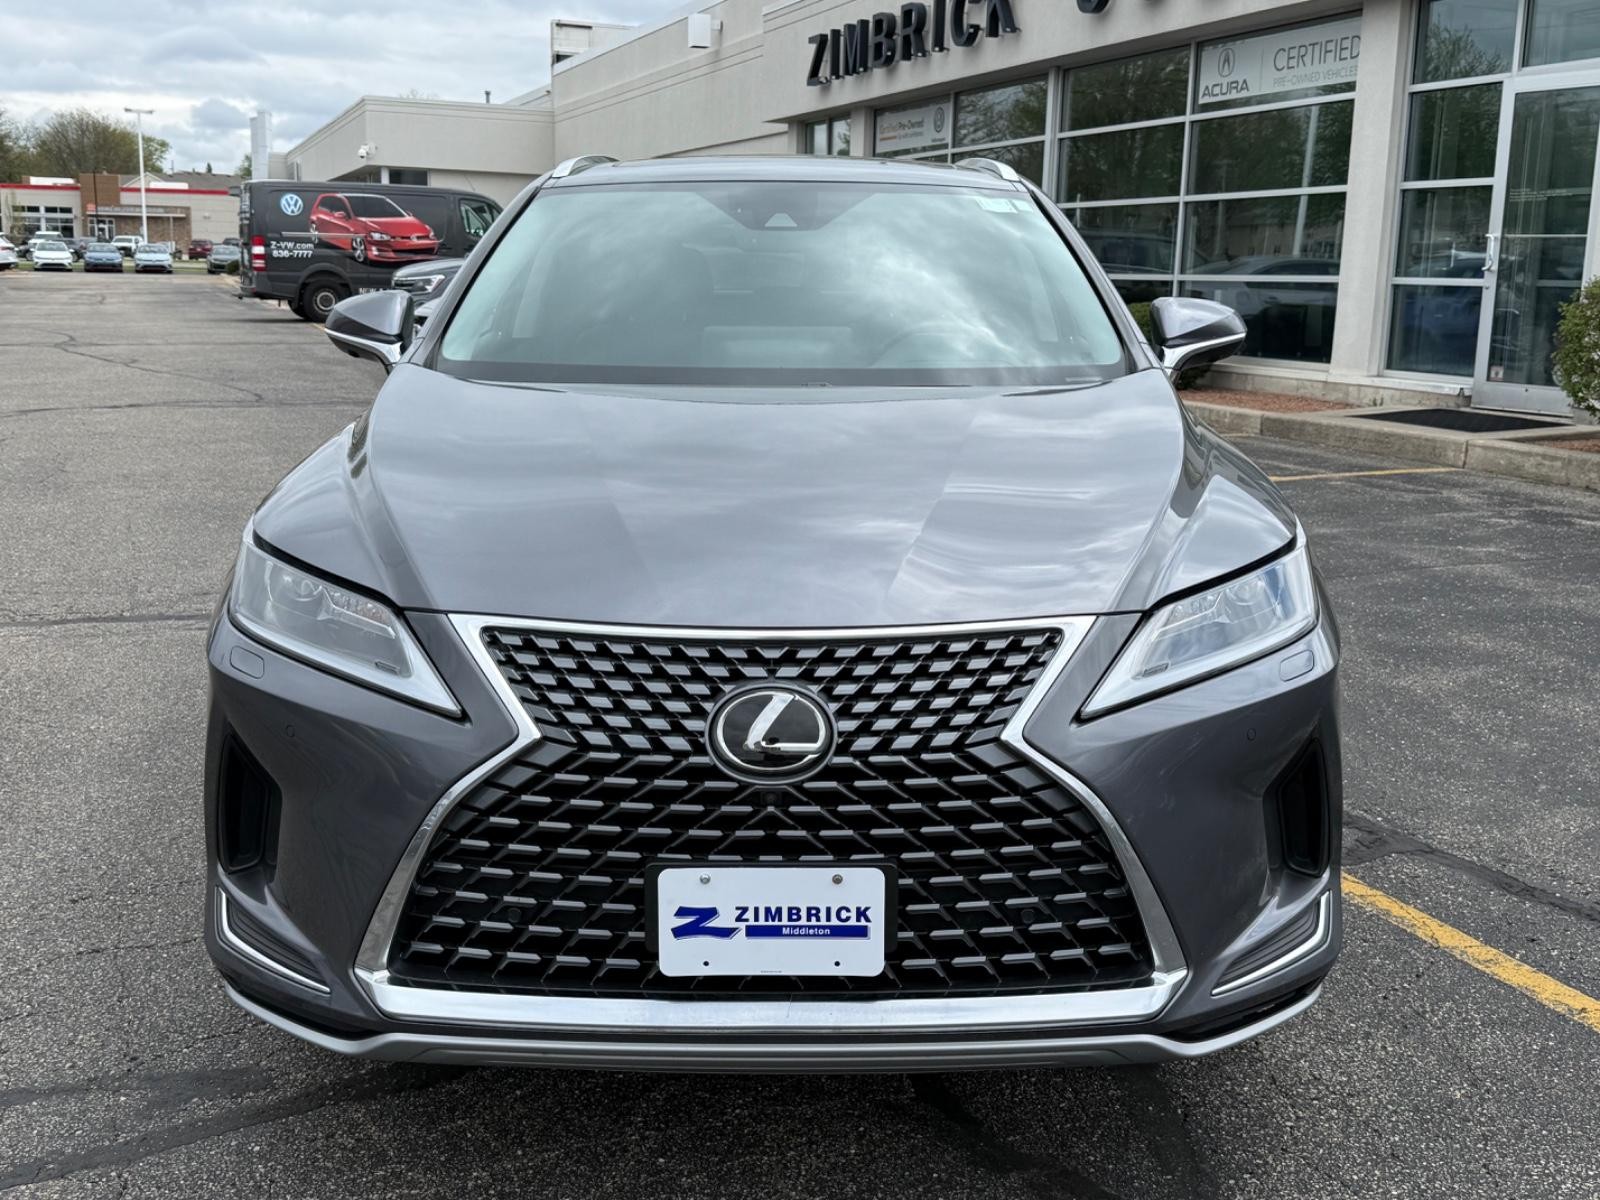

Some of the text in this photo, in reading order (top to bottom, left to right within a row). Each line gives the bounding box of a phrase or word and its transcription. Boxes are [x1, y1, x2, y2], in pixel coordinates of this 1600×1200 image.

[807, 0, 1021, 86] ZIMBRICK
[1273, 35, 1361, 72] CERTIFIED
[1201, 79, 1250, 99] ACURA
[270, 241, 315, 250] Z-VW.com
[735, 906, 872, 923] ZIMBRICK
[782, 926, 831, 936] Middleton
